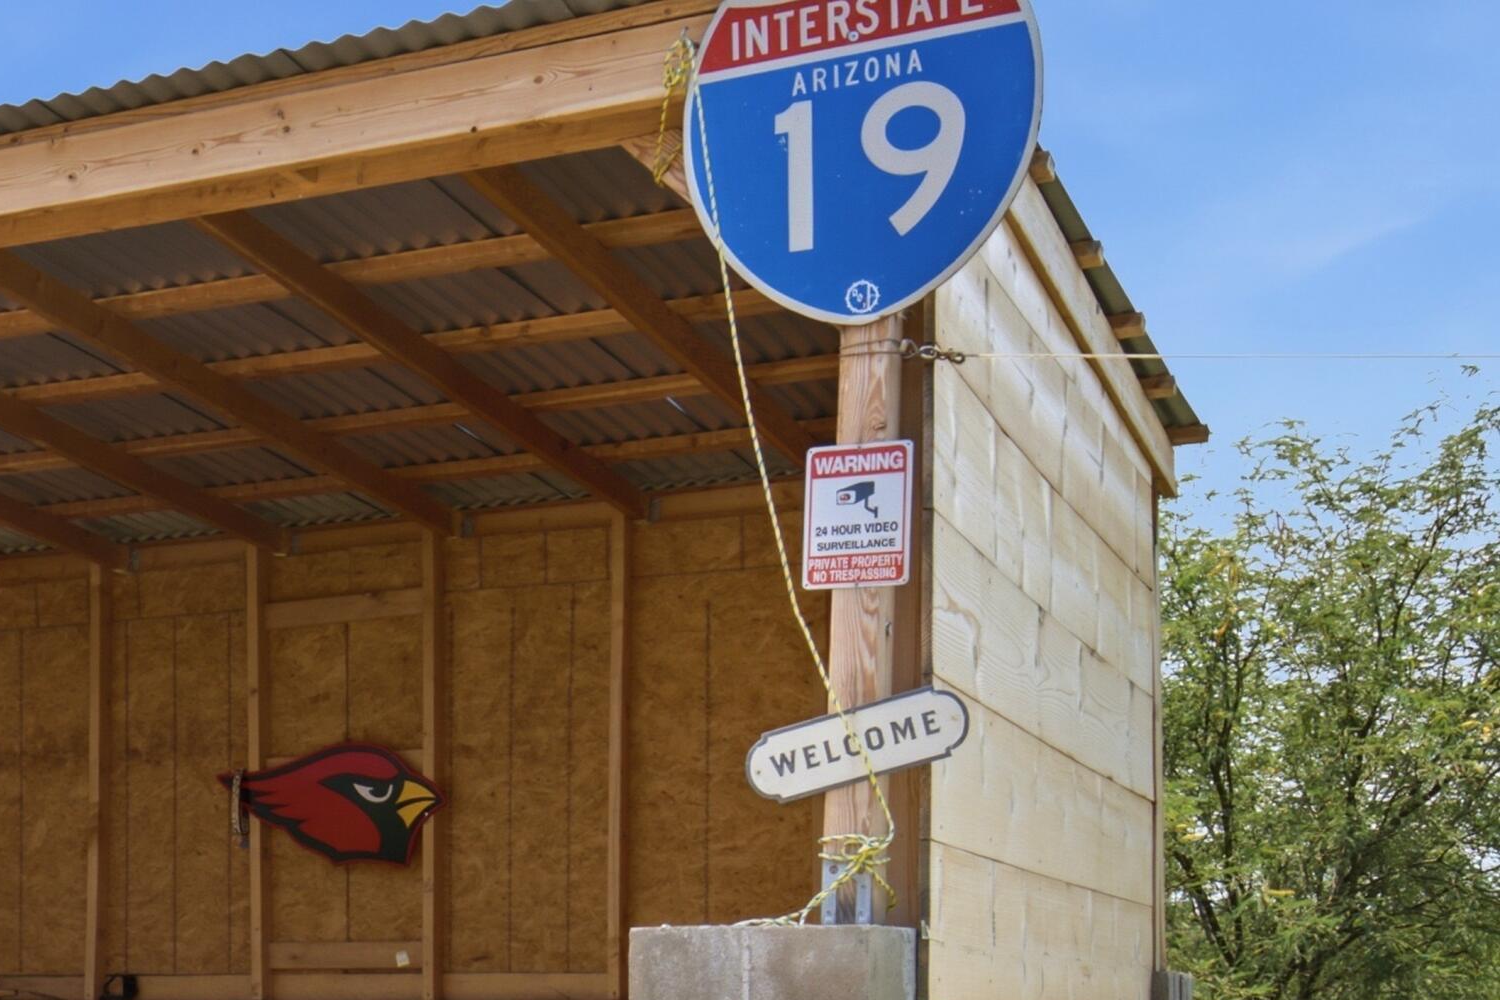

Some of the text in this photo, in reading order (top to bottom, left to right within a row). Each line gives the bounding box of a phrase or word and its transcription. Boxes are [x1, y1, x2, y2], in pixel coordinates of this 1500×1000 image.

[791, 49, 923, 97] ARIZONA
[774, 81, 966, 253] 19
[814, 452, 903, 475] WARNING
[815, 521, 899, 537] 24 HOUR VIDEO
[816, 538, 896, 552] SURVEILLANCE
[809, 553, 903, 570] PRIVATE PROPERTY
[812, 566, 897, 583] NO TRESPASSING
[769, 710, 941, 777] WELCOME
